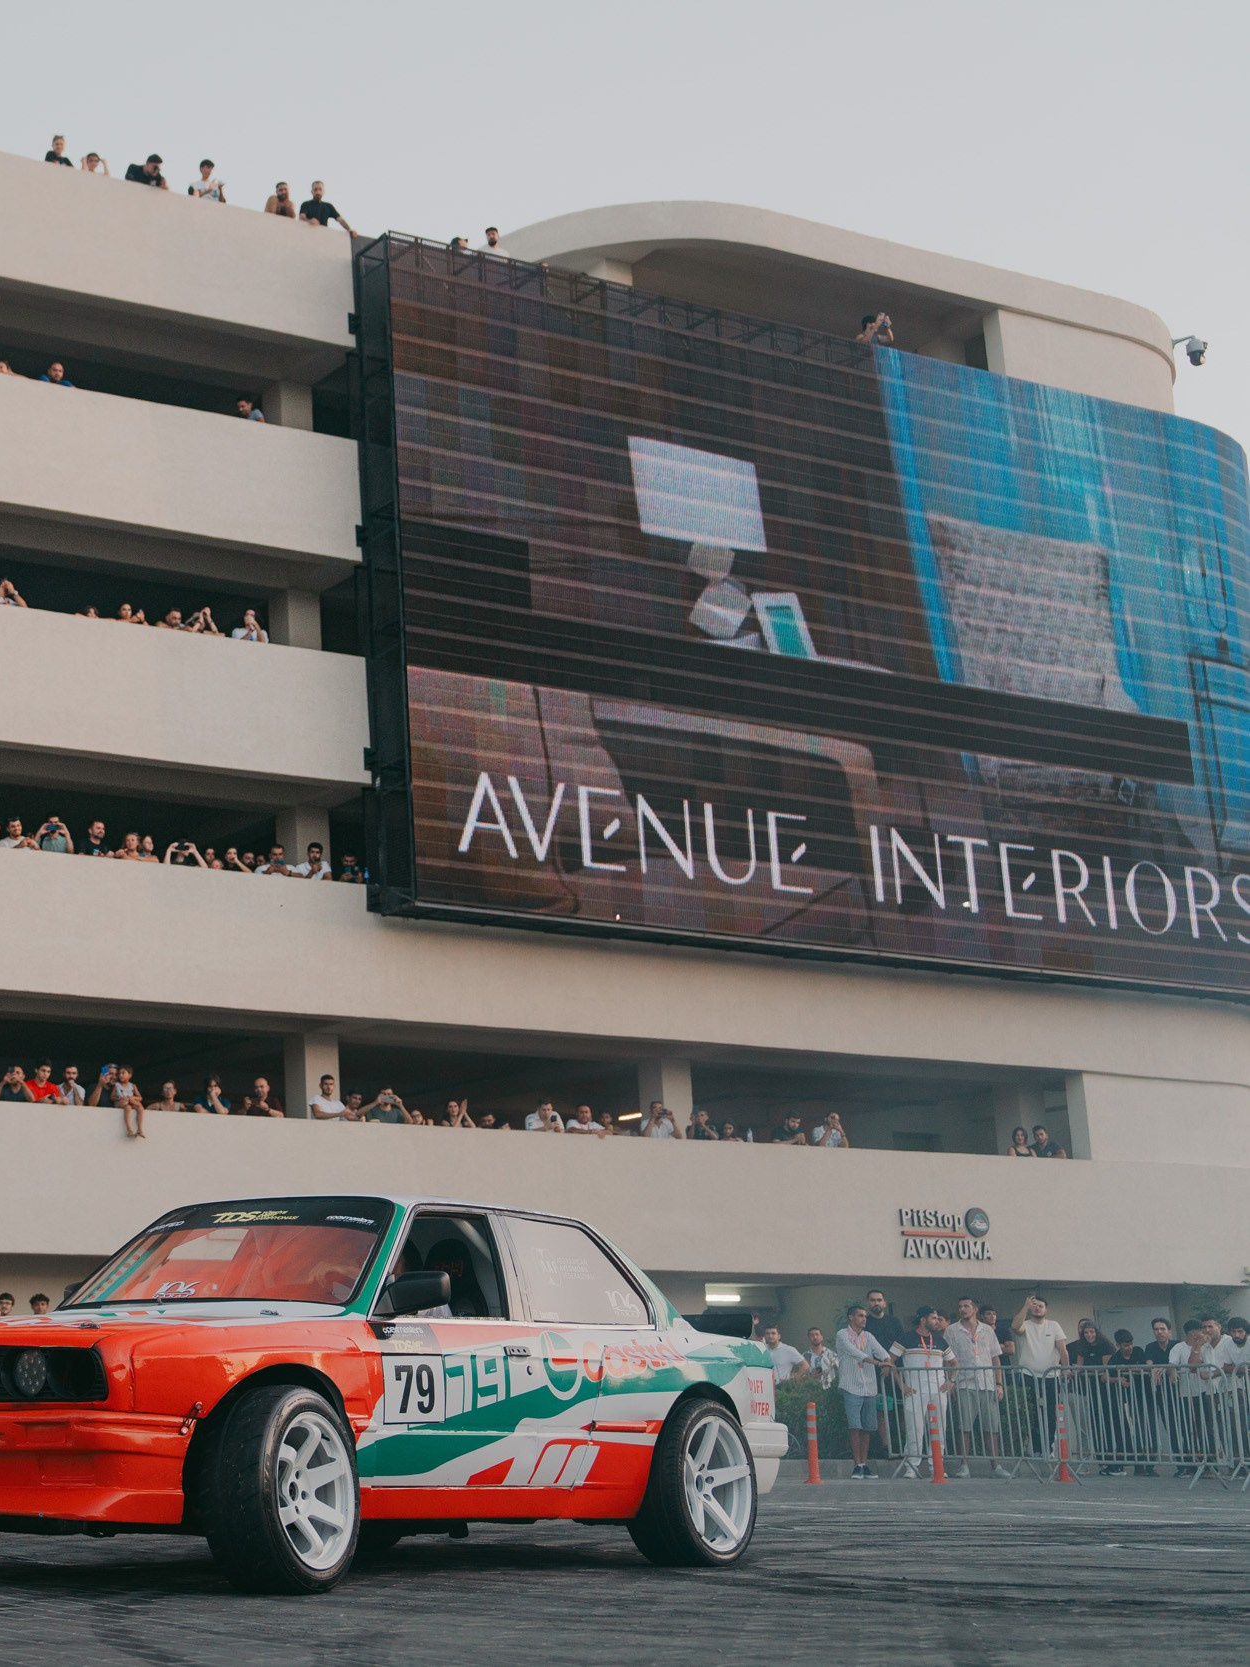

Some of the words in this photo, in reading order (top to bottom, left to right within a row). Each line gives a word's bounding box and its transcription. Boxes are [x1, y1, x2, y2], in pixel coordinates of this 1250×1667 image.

[458, 771, 813, 894] AVENUE
[899, 1208, 963, 1231] PitStop
[904, 1239, 992, 1260] AVTOYUMA
[394, 1364, 435, 1414] 79
